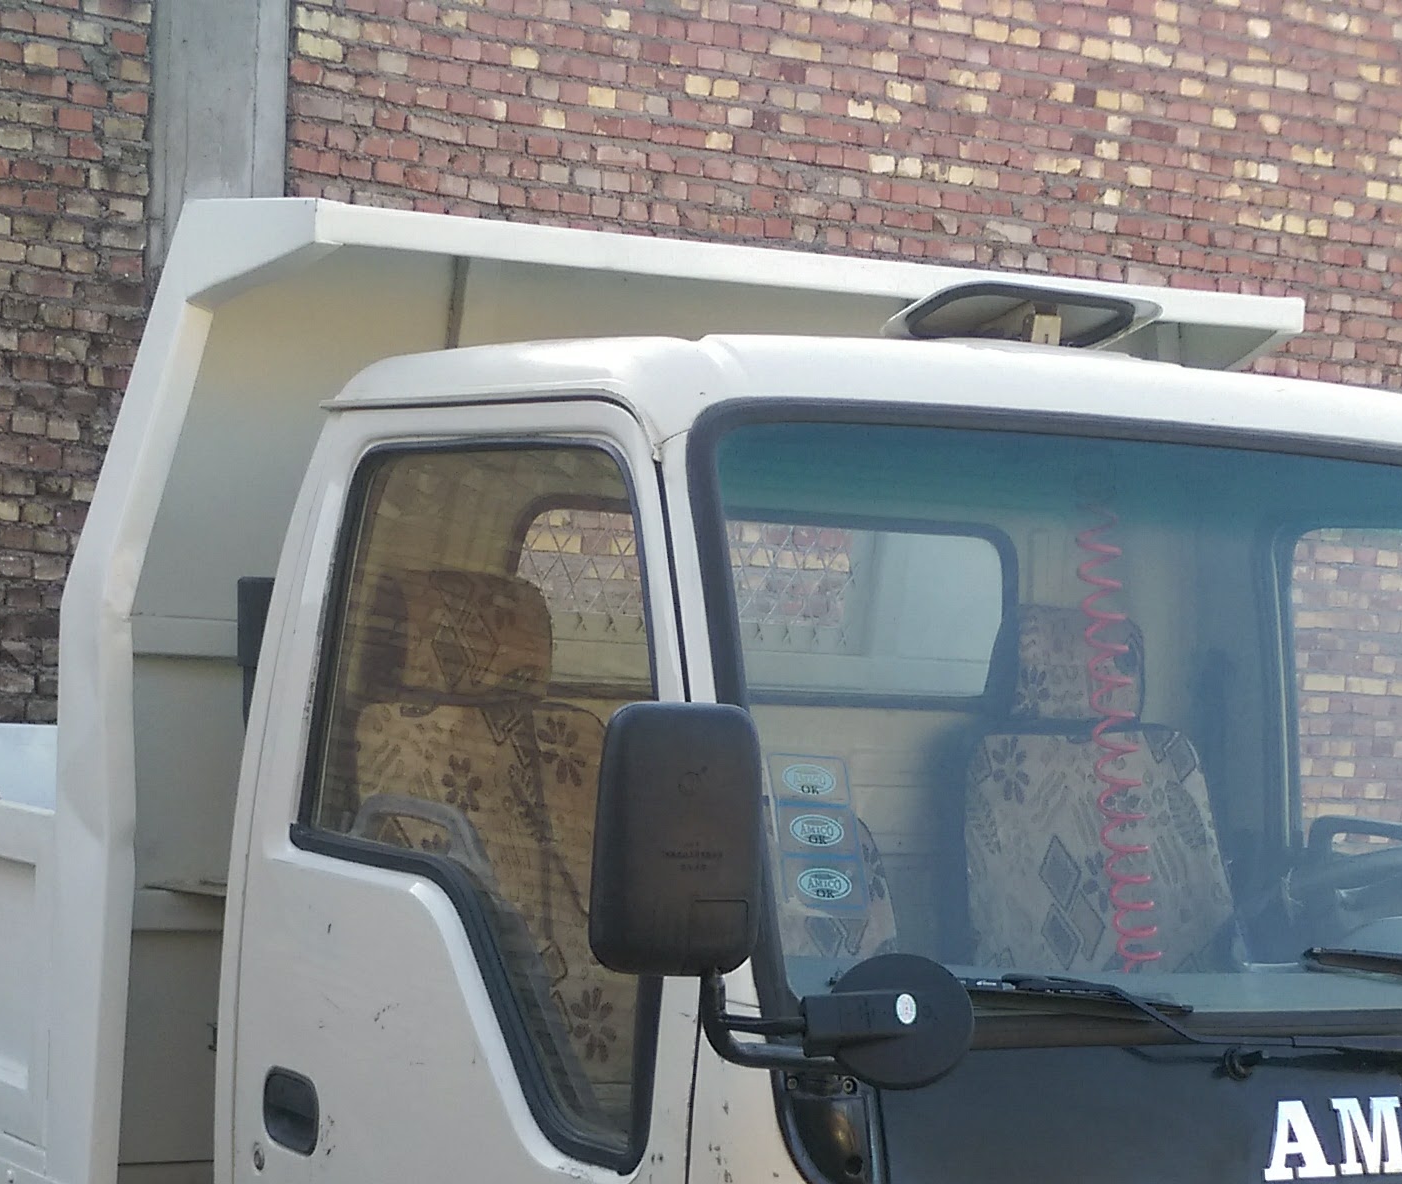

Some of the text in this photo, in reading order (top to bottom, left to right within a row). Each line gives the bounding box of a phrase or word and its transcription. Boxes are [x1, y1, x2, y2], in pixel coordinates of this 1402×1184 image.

[801, 784, 819, 795] OK
[800, 822, 834, 837] AMICO
[808, 834, 828, 845] OK
[807, 876, 842, 891] AMICO
[816, 888, 835, 899] OK
